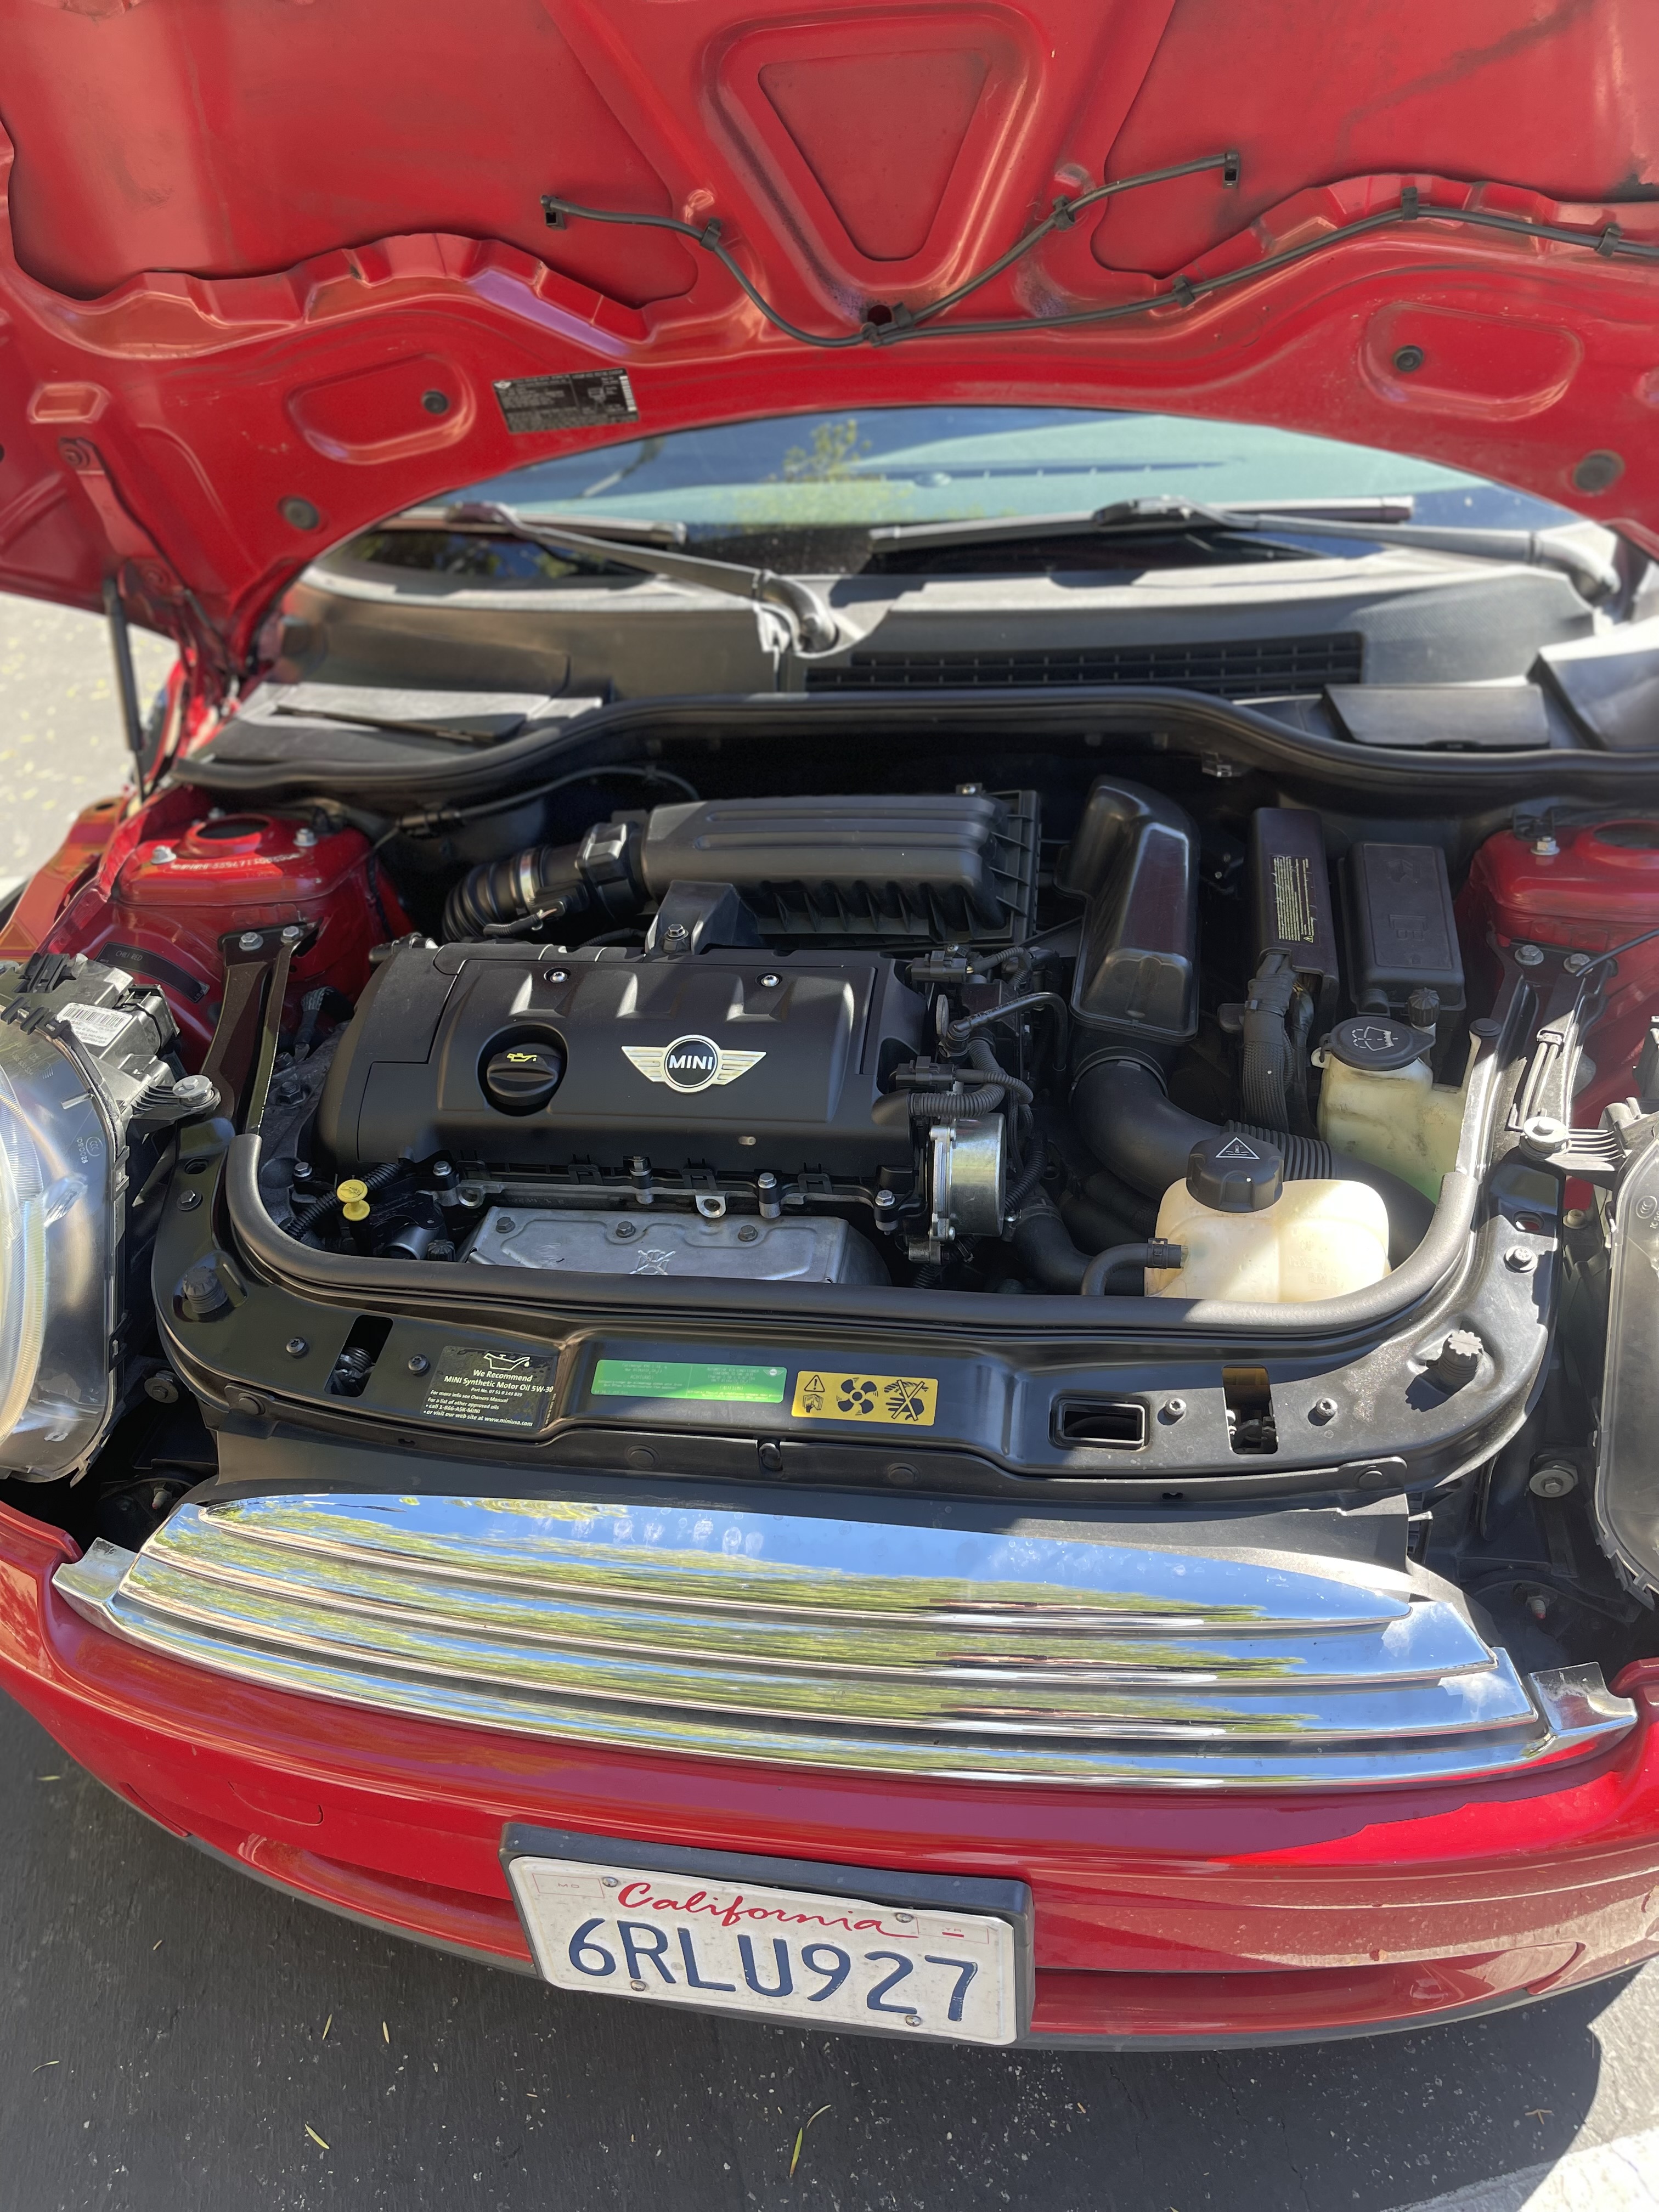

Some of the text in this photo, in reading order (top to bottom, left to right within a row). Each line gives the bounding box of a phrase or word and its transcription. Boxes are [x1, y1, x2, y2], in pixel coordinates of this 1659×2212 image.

[669, 1054, 713, 1070] MINI
[444, 1375, 462, 1384] MINI
[462, 1378, 496, 1387] Synthetic
[496, 1381, 519, 1390] Motor
[486, 1370, 533, 1382] Recommend
[439, 1404, 481, 1414] 1-866-ASK-MINI
[484, 1417, 533, 1426] www.miniusa.com
[618, 1882, 918, 1939] California
[568, 1917, 978, 2022] 6RLU927
